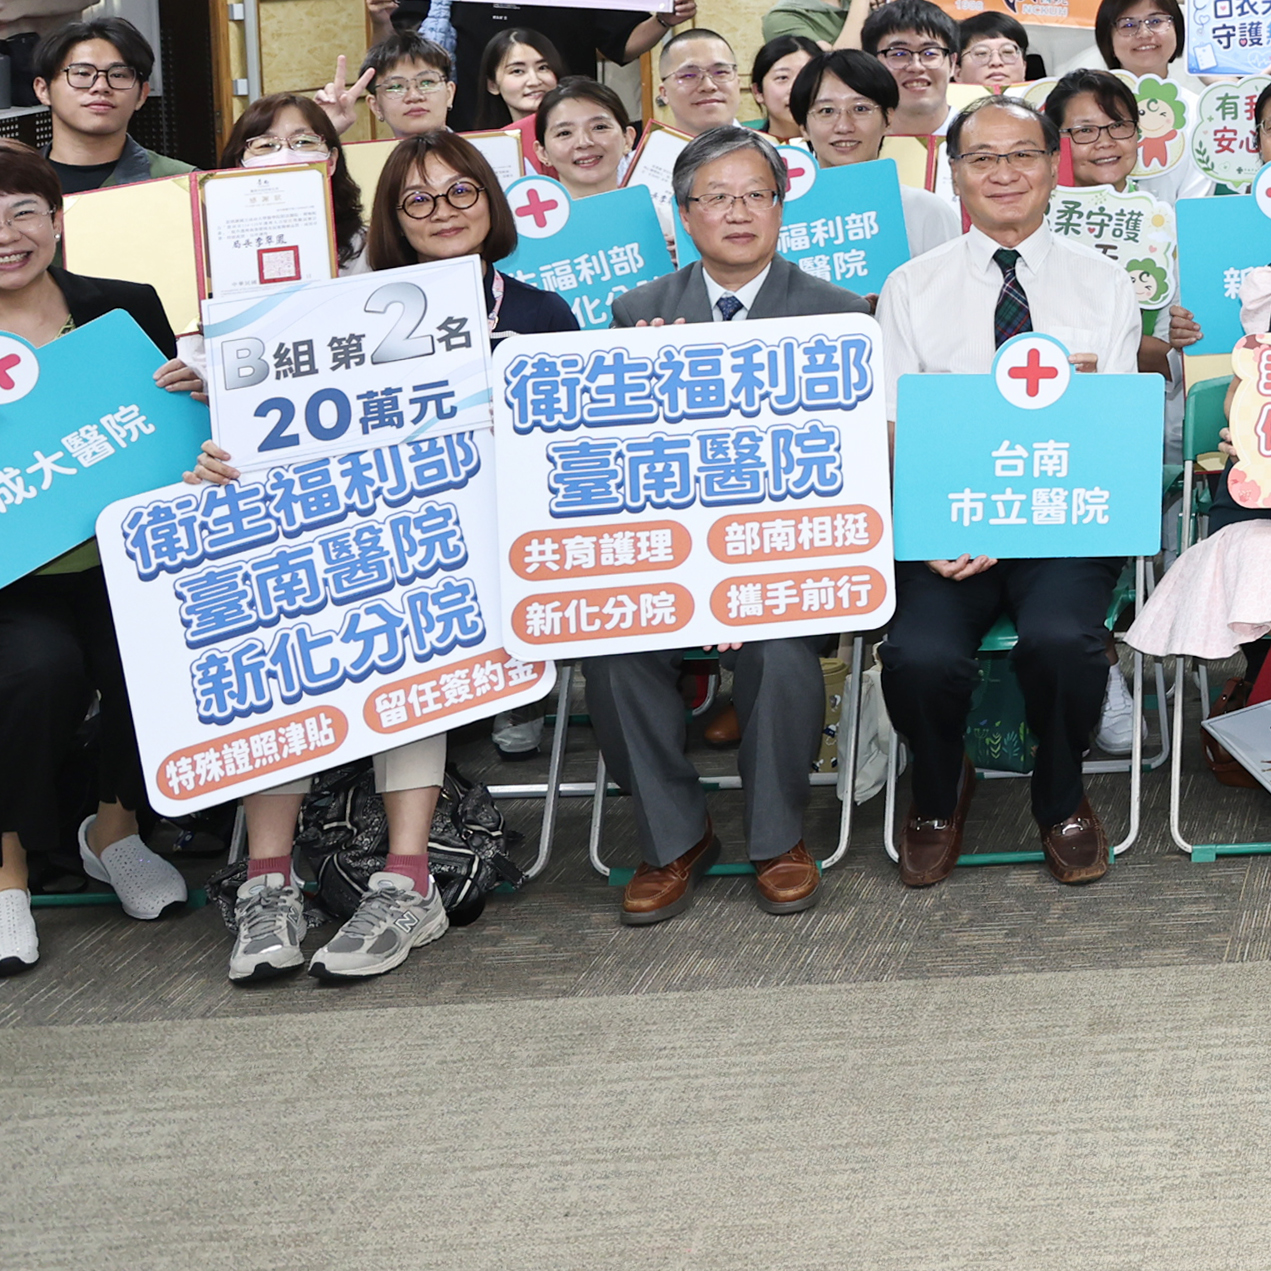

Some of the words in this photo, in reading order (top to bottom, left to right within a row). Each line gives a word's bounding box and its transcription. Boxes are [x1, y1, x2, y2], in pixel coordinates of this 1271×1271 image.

[1021, 2, 1069, 18] NCKUH
[775, 210, 880, 254] 福利部
[1046, 199, 1145, 245] 柔守護
[505, 333, 874, 435] 衛生福利部
[252, 379, 458, 453] 20萬元
[0, 401, 157, 515] 成大醫院
[546, 419, 844, 519] 臺南醫院
[991, 438, 1071, 479] 台南
[120, 430, 482, 581] 衛生福利部
[947, 486, 1111, 527] 市立醫院
[523, 528, 675, 574] 共育護理
[724, 512, 871, 557] 部南相挺
[175, 500, 469, 650] 臺南醫院
[726, 574, 873, 619] 攜手前行
[525, 591, 677, 637] 新化分院
[189, 576, 487, 725] 新化分院
[374, 656, 539, 729] 留任簽約金
[163, 711, 337, 795] 特殊證照津貼
[394, 910, 419, 934] N
